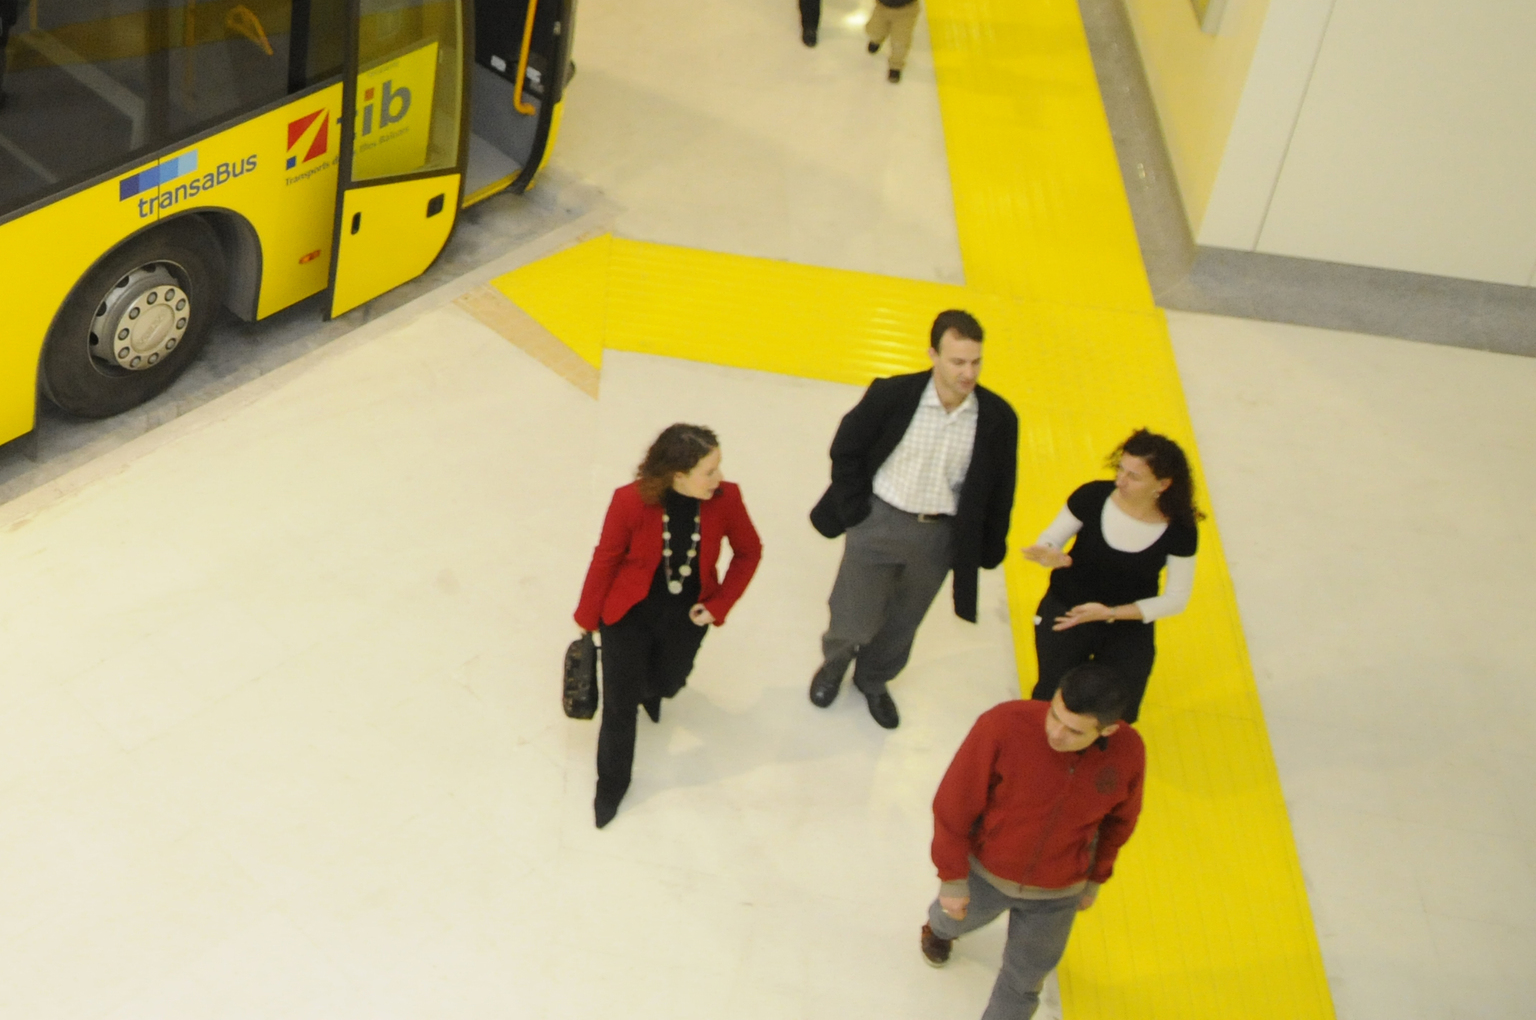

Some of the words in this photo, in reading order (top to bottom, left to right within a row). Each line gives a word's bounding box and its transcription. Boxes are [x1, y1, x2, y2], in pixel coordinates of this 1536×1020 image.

[337, 80, 412, 138] ib
[138, 154, 257, 218] transaBus
[285, 160, 330, 186] Transports
